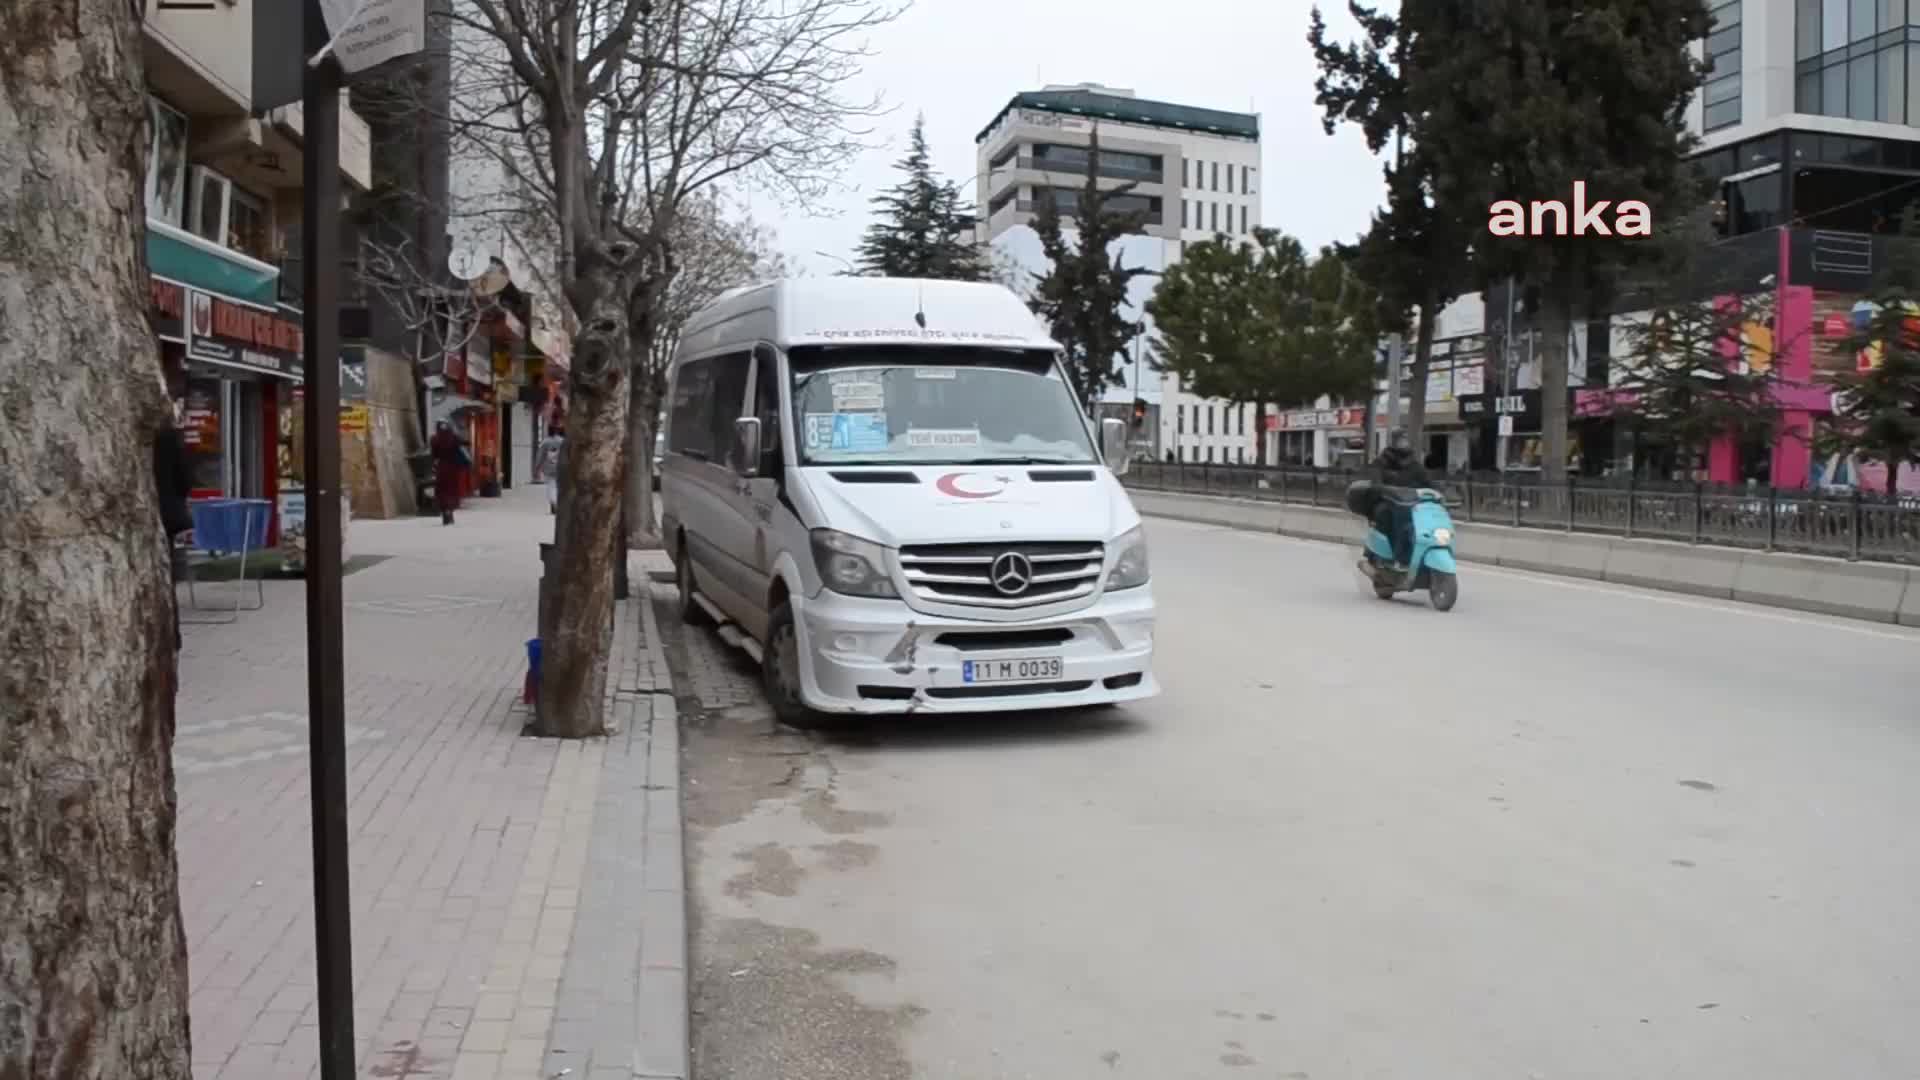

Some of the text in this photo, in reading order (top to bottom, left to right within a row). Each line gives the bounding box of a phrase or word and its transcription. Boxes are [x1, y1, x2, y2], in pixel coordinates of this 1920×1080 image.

[975, 660, 1060, 679] 11 M 0039
